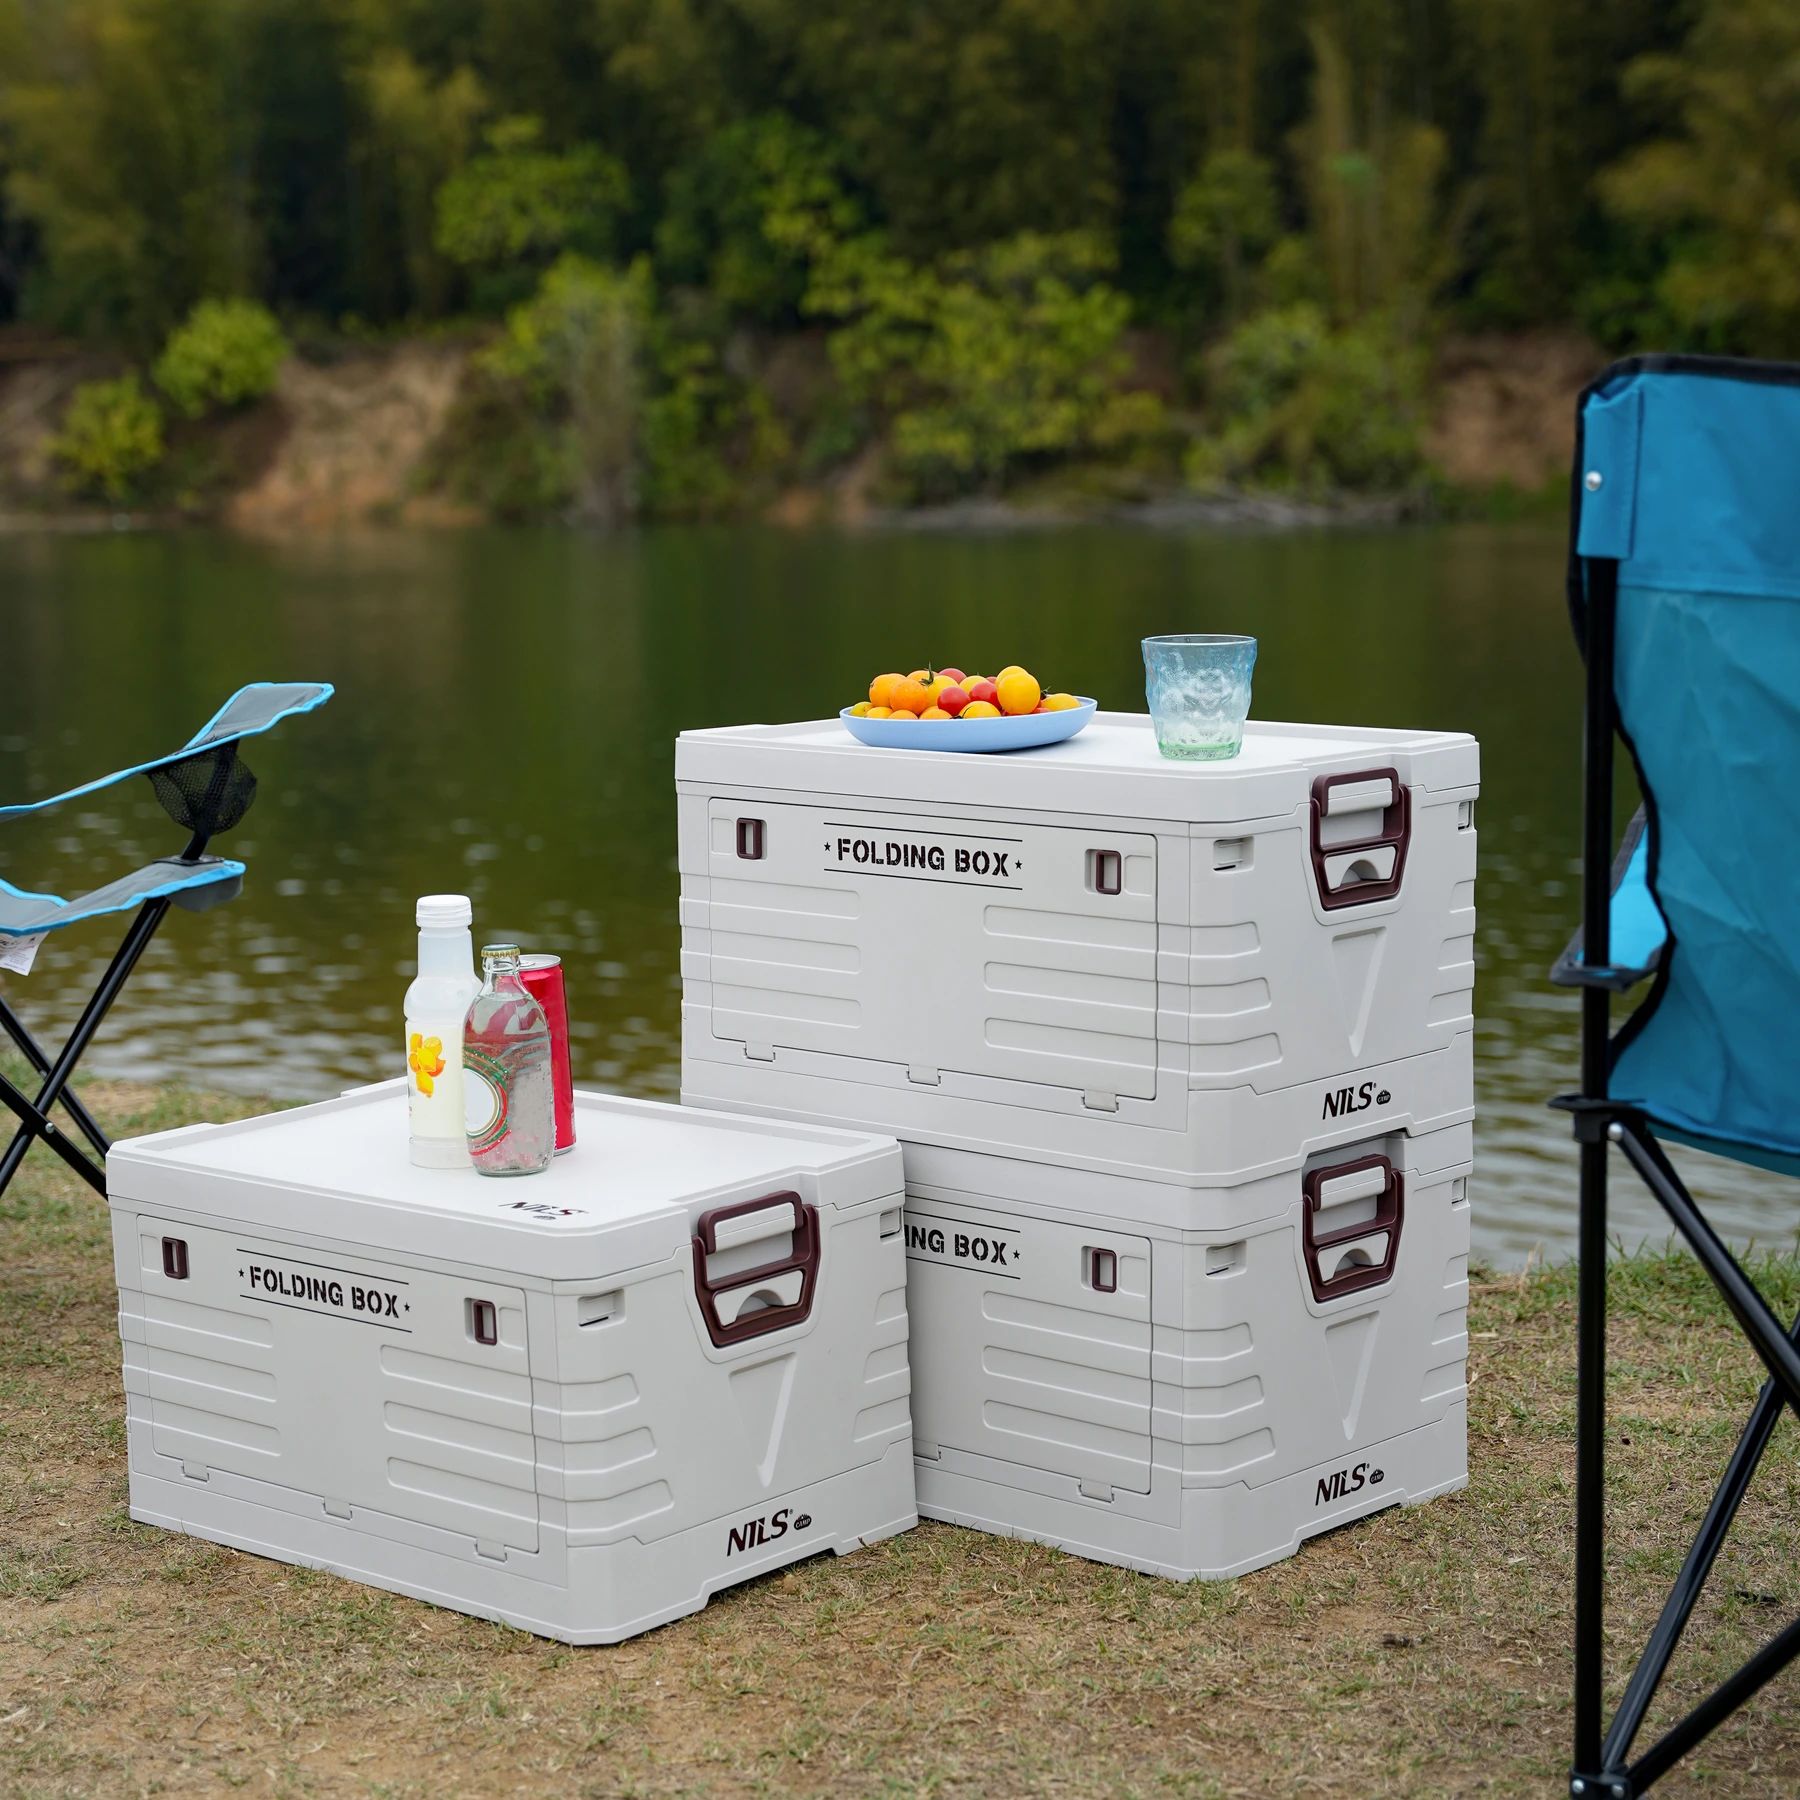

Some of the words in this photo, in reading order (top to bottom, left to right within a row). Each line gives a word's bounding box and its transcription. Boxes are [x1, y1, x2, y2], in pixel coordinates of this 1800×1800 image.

[837, 837, 945, 871] FOLDING
[955, 848, 1009, 878] BOX
[1322, 1081, 1373, 1120] NILS
[954, 1233, 1007, 1266] BOX
[249, 1265, 344, 1307] FOLDING
[351, 1286, 399, 1319] BOX
[1315, 1462, 1367, 1506] NILS
[726, 1508, 789, 1557] NILS
